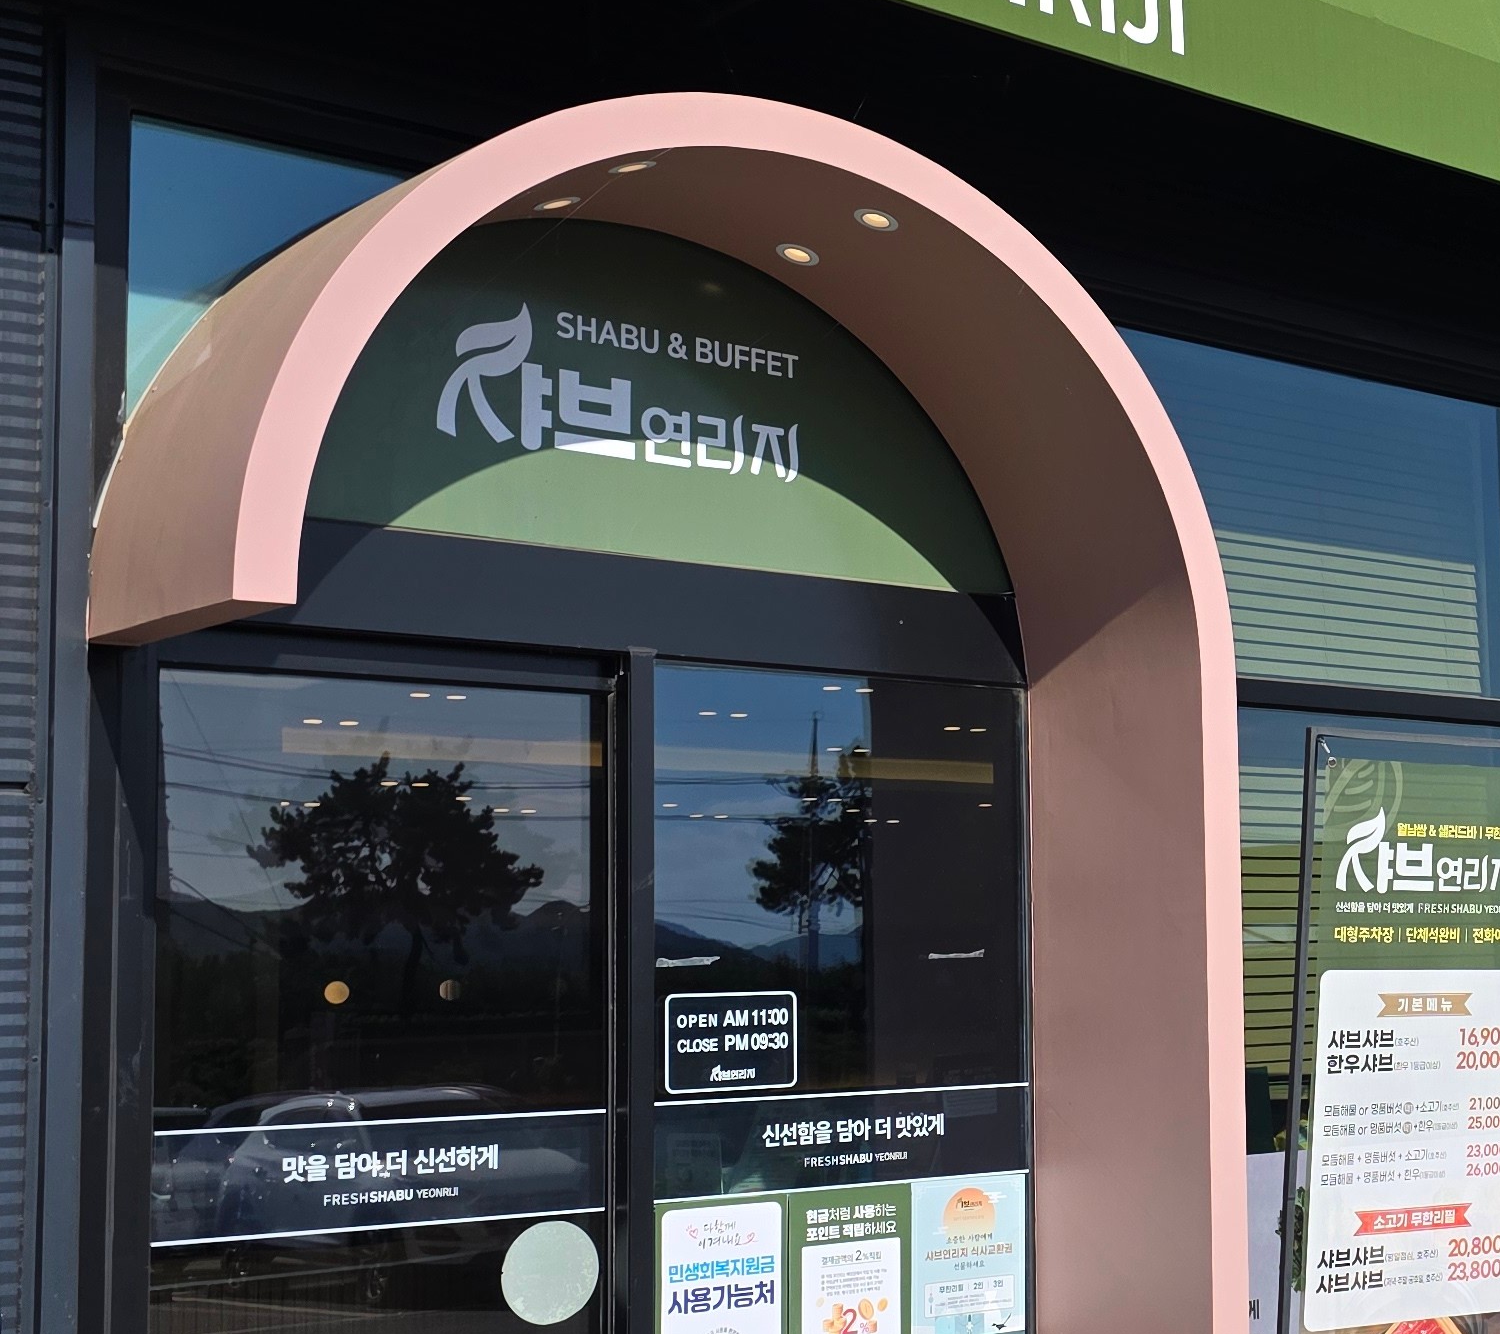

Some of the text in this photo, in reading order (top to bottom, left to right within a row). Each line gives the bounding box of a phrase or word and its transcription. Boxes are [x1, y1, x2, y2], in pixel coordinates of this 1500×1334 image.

[556, 312, 799, 379] SHABU & BUFFET
[437, 301, 799, 482] 샤브연리지
[1334, 926, 1395, 943] 대형주차장
[1405, 927, 1461, 944] 단체석완비
[676, 1008, 789, 1028] OPEN AM 11:00
[676, 1032, 789, 1053] CLOSE PM 09:30
[1358, 1106, 1369, 1117] or
[761, 1113, 945, 1148] 신선함을 담아 더 맛있게
[1357, 1125, 1368, 1136] or
[282, 1143, 499, 1184] 맛을 담아 더 신선하게
[806, 1203, 897, 1224] 현금처럼 사용하는
[1373, 1210, 1456, 1230] 소고기 무한리필
[703, 1219, 736, 1234] 다함께
[806, 1221, 897, 1242] 포인트 적립하세요
[971, 1243, 1013, 1257] 식사교환권
[668, 1255, 775, 1284] 민생회복지원금
[668, 1280, 775, 1315] 사용가능처
